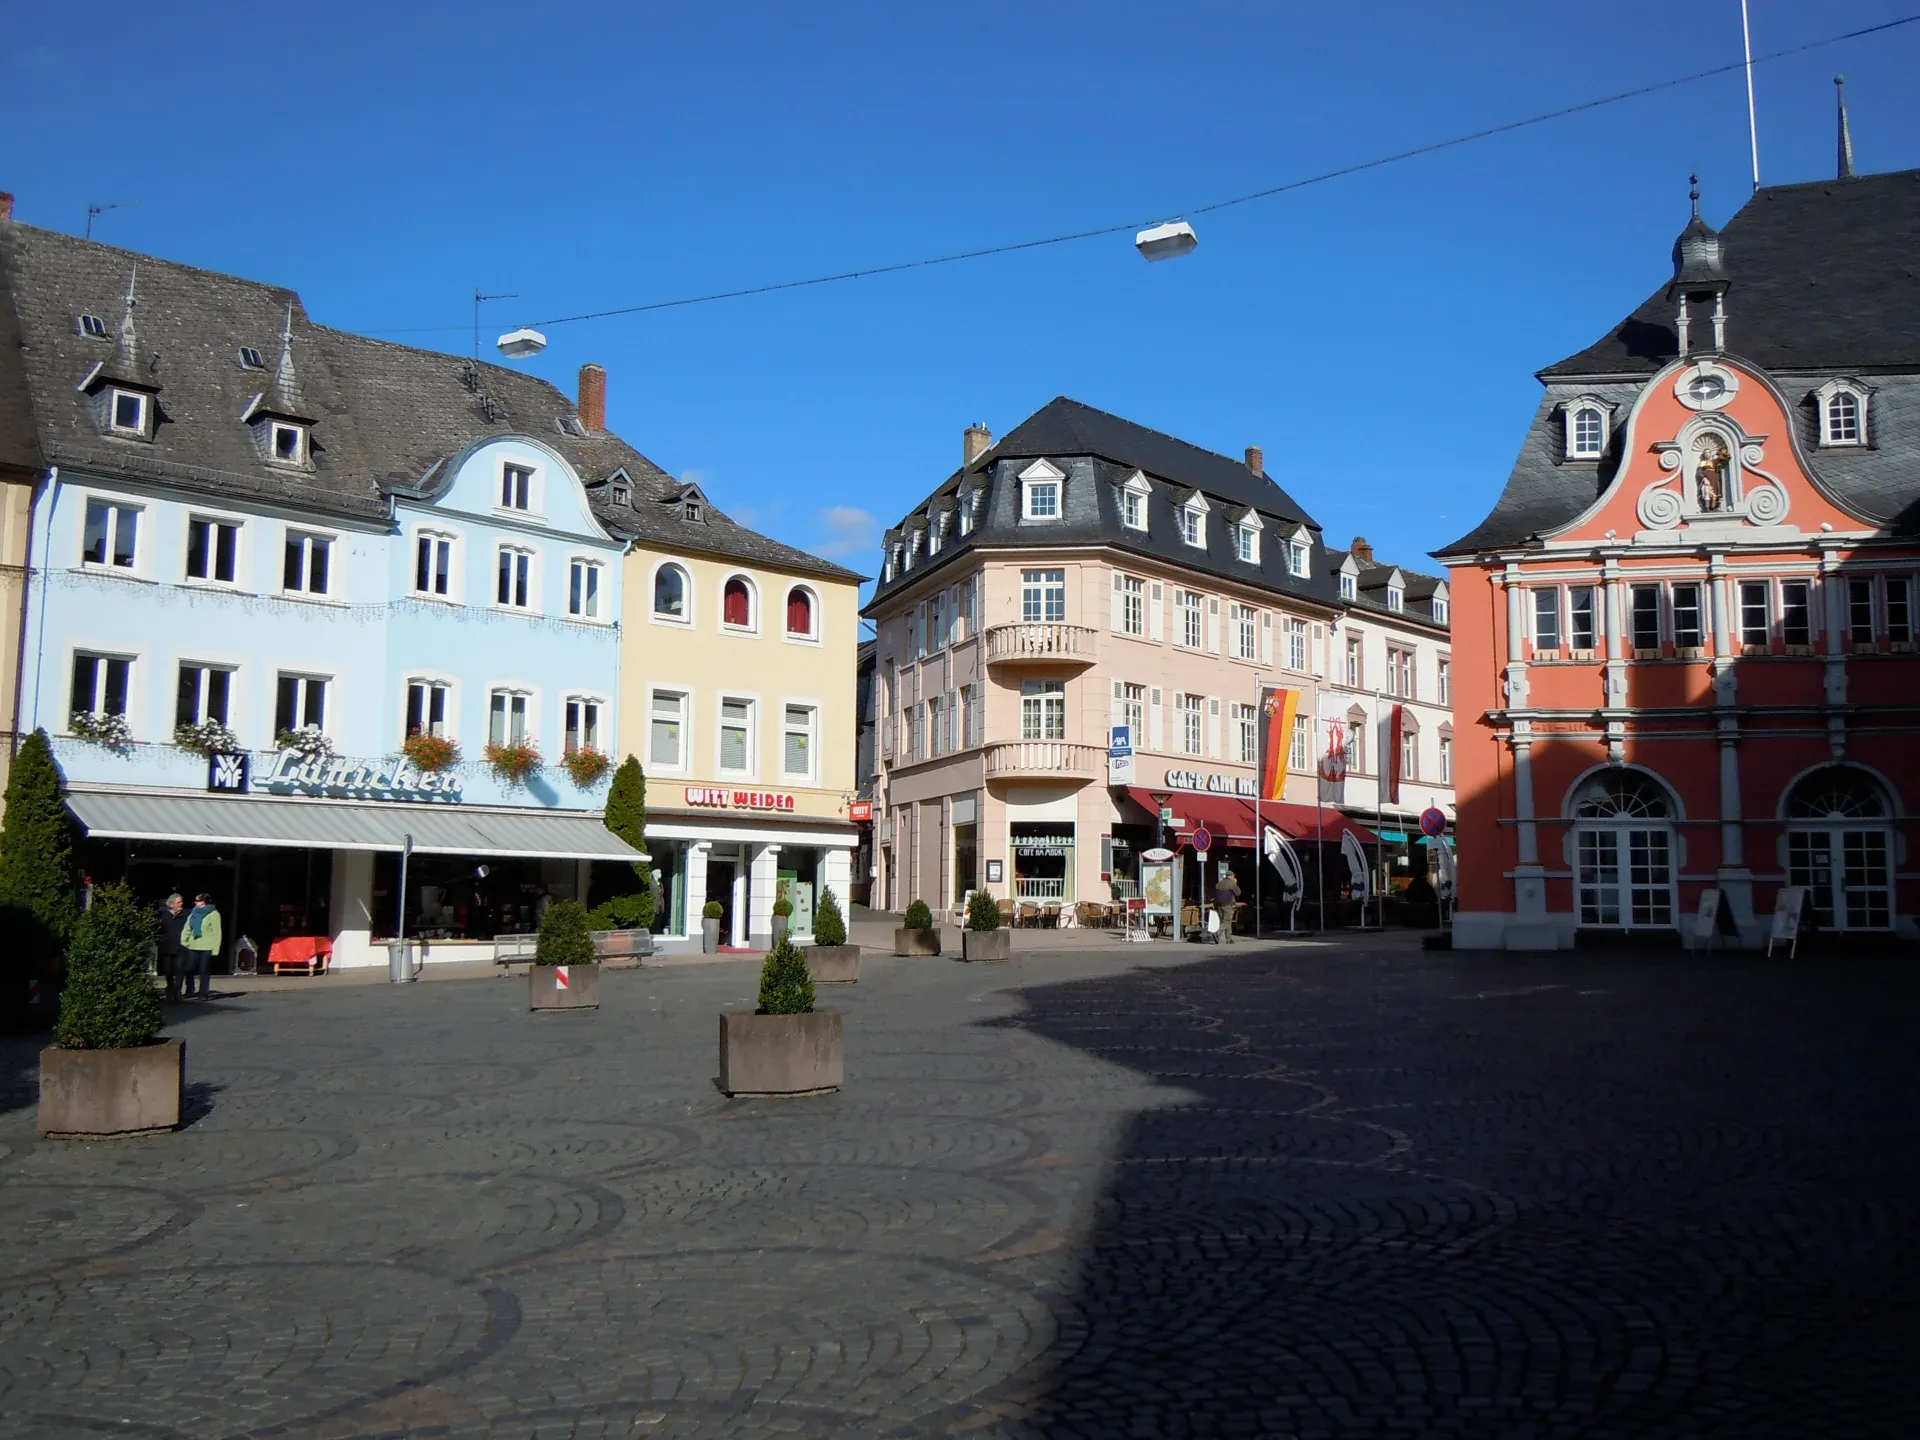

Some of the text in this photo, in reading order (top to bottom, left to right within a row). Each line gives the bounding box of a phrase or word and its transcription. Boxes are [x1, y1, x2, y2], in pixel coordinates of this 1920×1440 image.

[1112, 737, 1127, 747] AXA
[1165, 769, 1205, 790] CAFE
[1208, 774, 1234, 793] AM
[685, 787, 795, 811] WITT WEIDEN
[853, 806, 869, 815] WITT
[1018, 848, 1034, 857] CAFE
